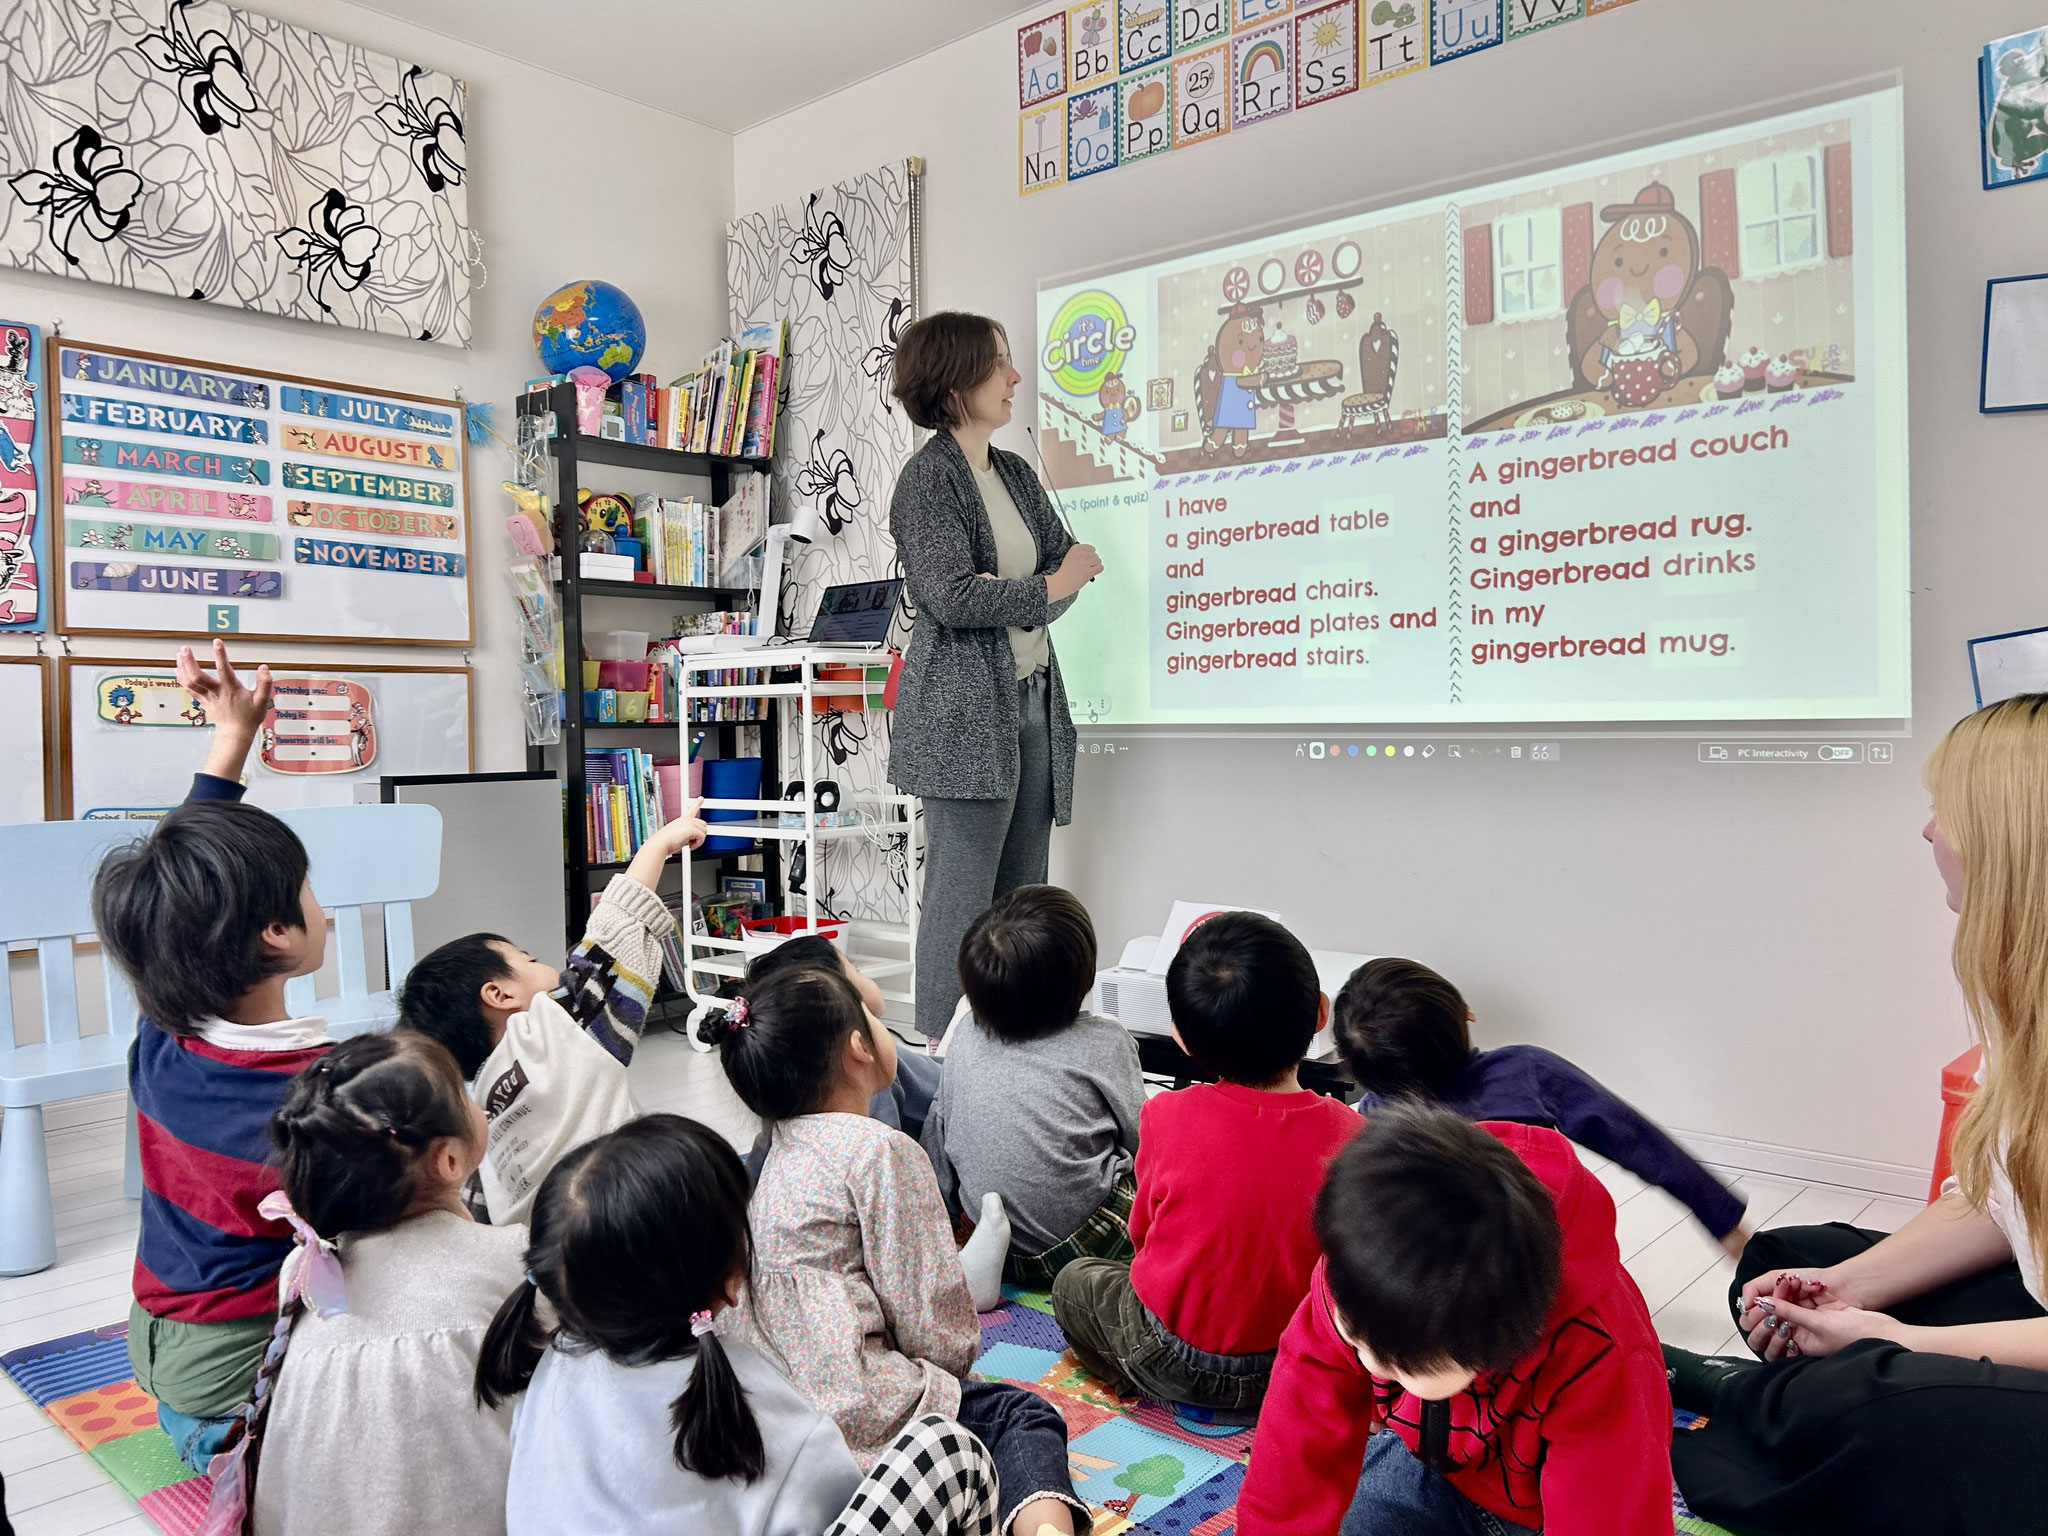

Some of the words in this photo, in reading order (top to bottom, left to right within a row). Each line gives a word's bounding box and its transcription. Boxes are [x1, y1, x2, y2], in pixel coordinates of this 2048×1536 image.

[1182, 8, 1219, 41] Dd
[1442, 9, 1489, 47] Uu
[1127, 30, 1162, 61] Cc
[1369, 33, 1414, 71] Tt
[1075, 49, 1109, 81] Bb
[1305, 60, 1347, 95] Ss
[1028, 68, 1060, 99] Aa
[1243, 80, 1281, 116] Rr
[1182, 103, 1221, 136] Qq
[1075, 137, 1109, 167] Oo
[1128, 121, 1163, 154] Pp
[1025, 153, 1056, 185] Nn
[1042, 318, 1136, 372] Circle
[1081, 356, 1101, 367] time
[98, 363, 237, 401] JANUARY
[89, 401, 245, 438] FEBRUARY
[341, 401, 401, 425] JULY
[117, 445, 222, 476] MARCH
[323, 433, 423, 462] AUGUST
[1468, 461, 1487, 484] A
[1497, 438, 1677, 486] gingerbread
[1690, 424, 1788, 459] couch
[126, 487, 218, 513] APRIL
[296, 468, 442, 502] SEPTEMBER
[1080, 496, 1109, 512] (point
[1113, 494, 1121, 506] &
[1123, 490, 1149, 507] quiz)
[1165, 500, 1170, 517] I
[1178, 495, 1228, 515] have
[1469, 494, 1521, 518] and
[316, 507, 432, 535] OCTOBER
[1165, 533, 1178, 548] a
[1187, 514, 1320, 550] gingerbread
[1329, 508, 1389, 533] table
[1470, 535, 1487, 554] a
[1498, 515, 1677, 557] gingerbread
[1690, 510, 1752, 540] rug.
[144, 526, 206, 551] MAY
[314, 544, 448, 574] NOVEMBER
[1165, 559, 1204, 579] and
[1470, 556, 1650, 592] Gingerbread
[1662, 548, 1756, 577] drinks
[141, 568, 219, 592] JUNE
[1166, 583, 1296, 613] gingerbread
[1306, 578, 1379, 602] chairs.
[216, 609, 230, 629] 5
[1166, 614, 1300, 644] Gingerbread
[1310, 611, 1380, 639] plates
[1389, 606, 1437, 630] and
[1470, 603, 1494, 626] in
[1505, 602, 1546, 628] my
[1166, 647, 1297, 675] gingerbread
[1306, 644, 1370, 667] stairs.
[1470, 631, 1646, 665] gingerbread
[1659, 629, 1735, 658] mug.
[123, 678, 155, 689] Today's
[273, 686, 310, 696] Yesterday
[275, 711, 297, 720] Today
[626, 699, 638, 716] 6
[312, 736, 324, 744] will
[1737, 748, 1751, 758] PC
[1752, 748, 1809, 760] Interactivity
[1833, 749, 1851, 757] OFF
[498, 1104, 532, 1132] CONTINUE
